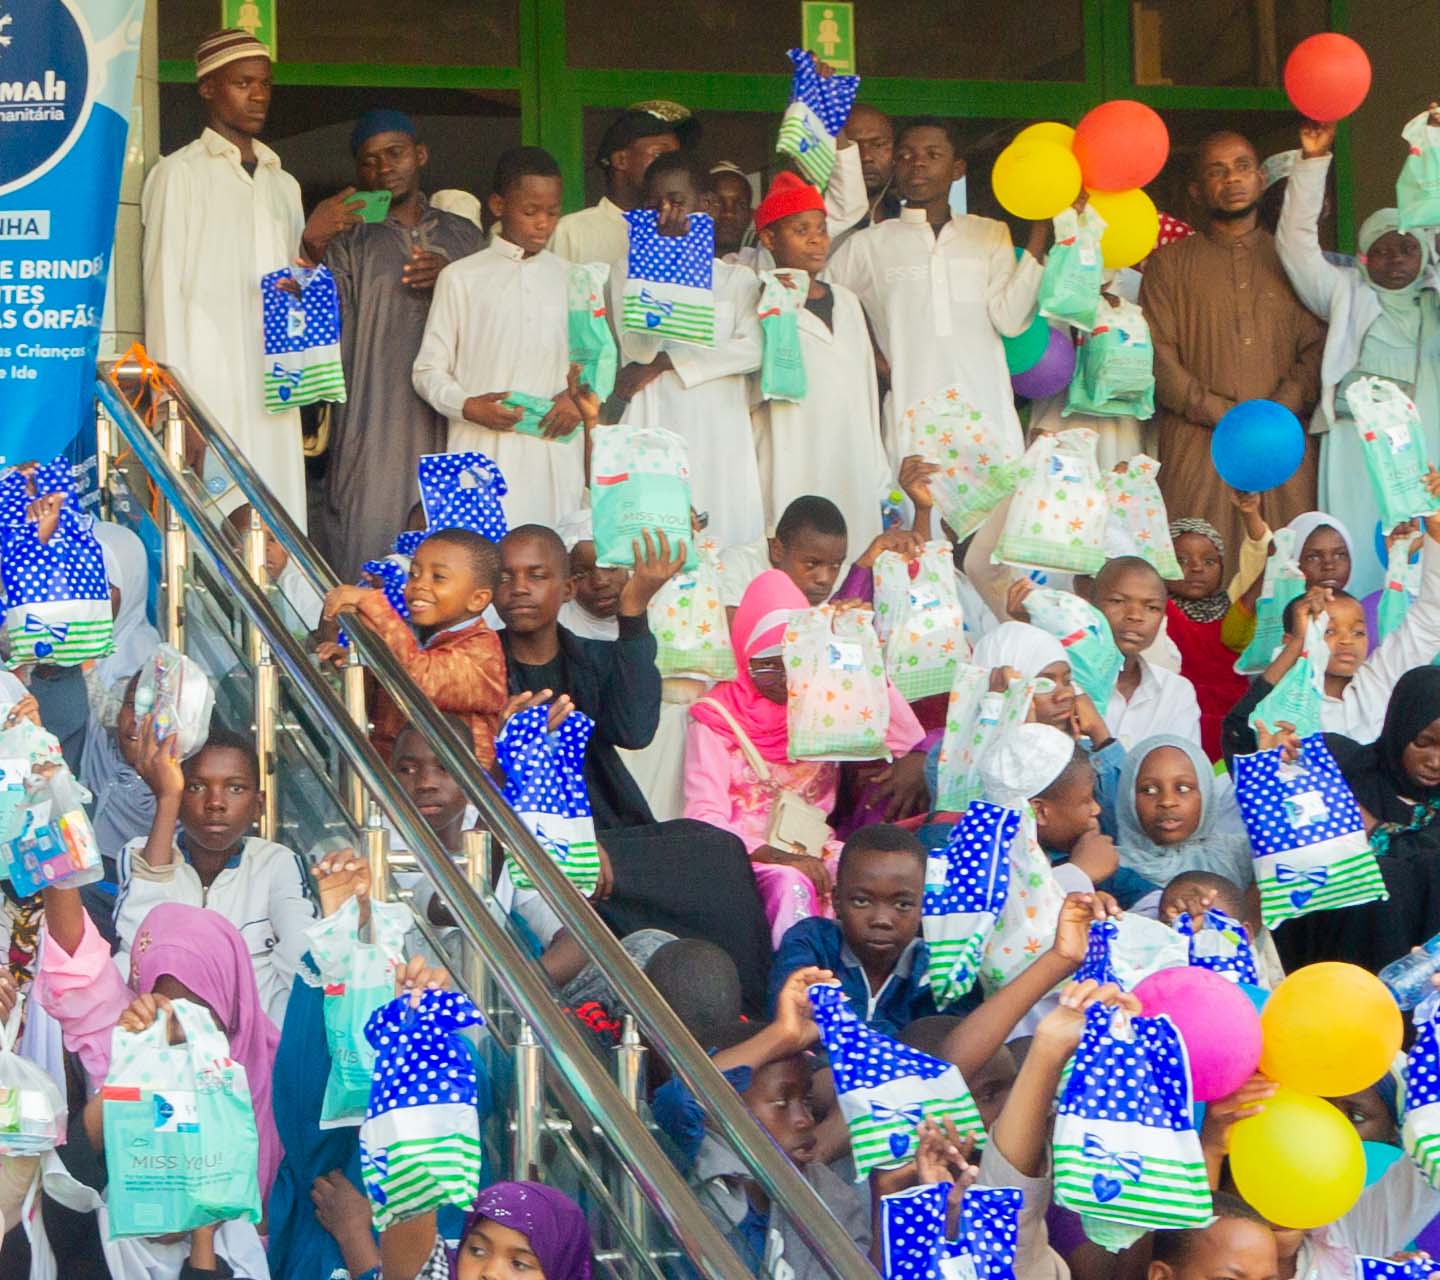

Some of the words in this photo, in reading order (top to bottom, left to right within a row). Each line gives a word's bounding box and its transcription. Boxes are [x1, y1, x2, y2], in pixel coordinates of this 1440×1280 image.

[15, 343, 86, 362] Crianças
[10, 365, 38, 380] Ide
[131, 1155, 177, 1169] MISS
